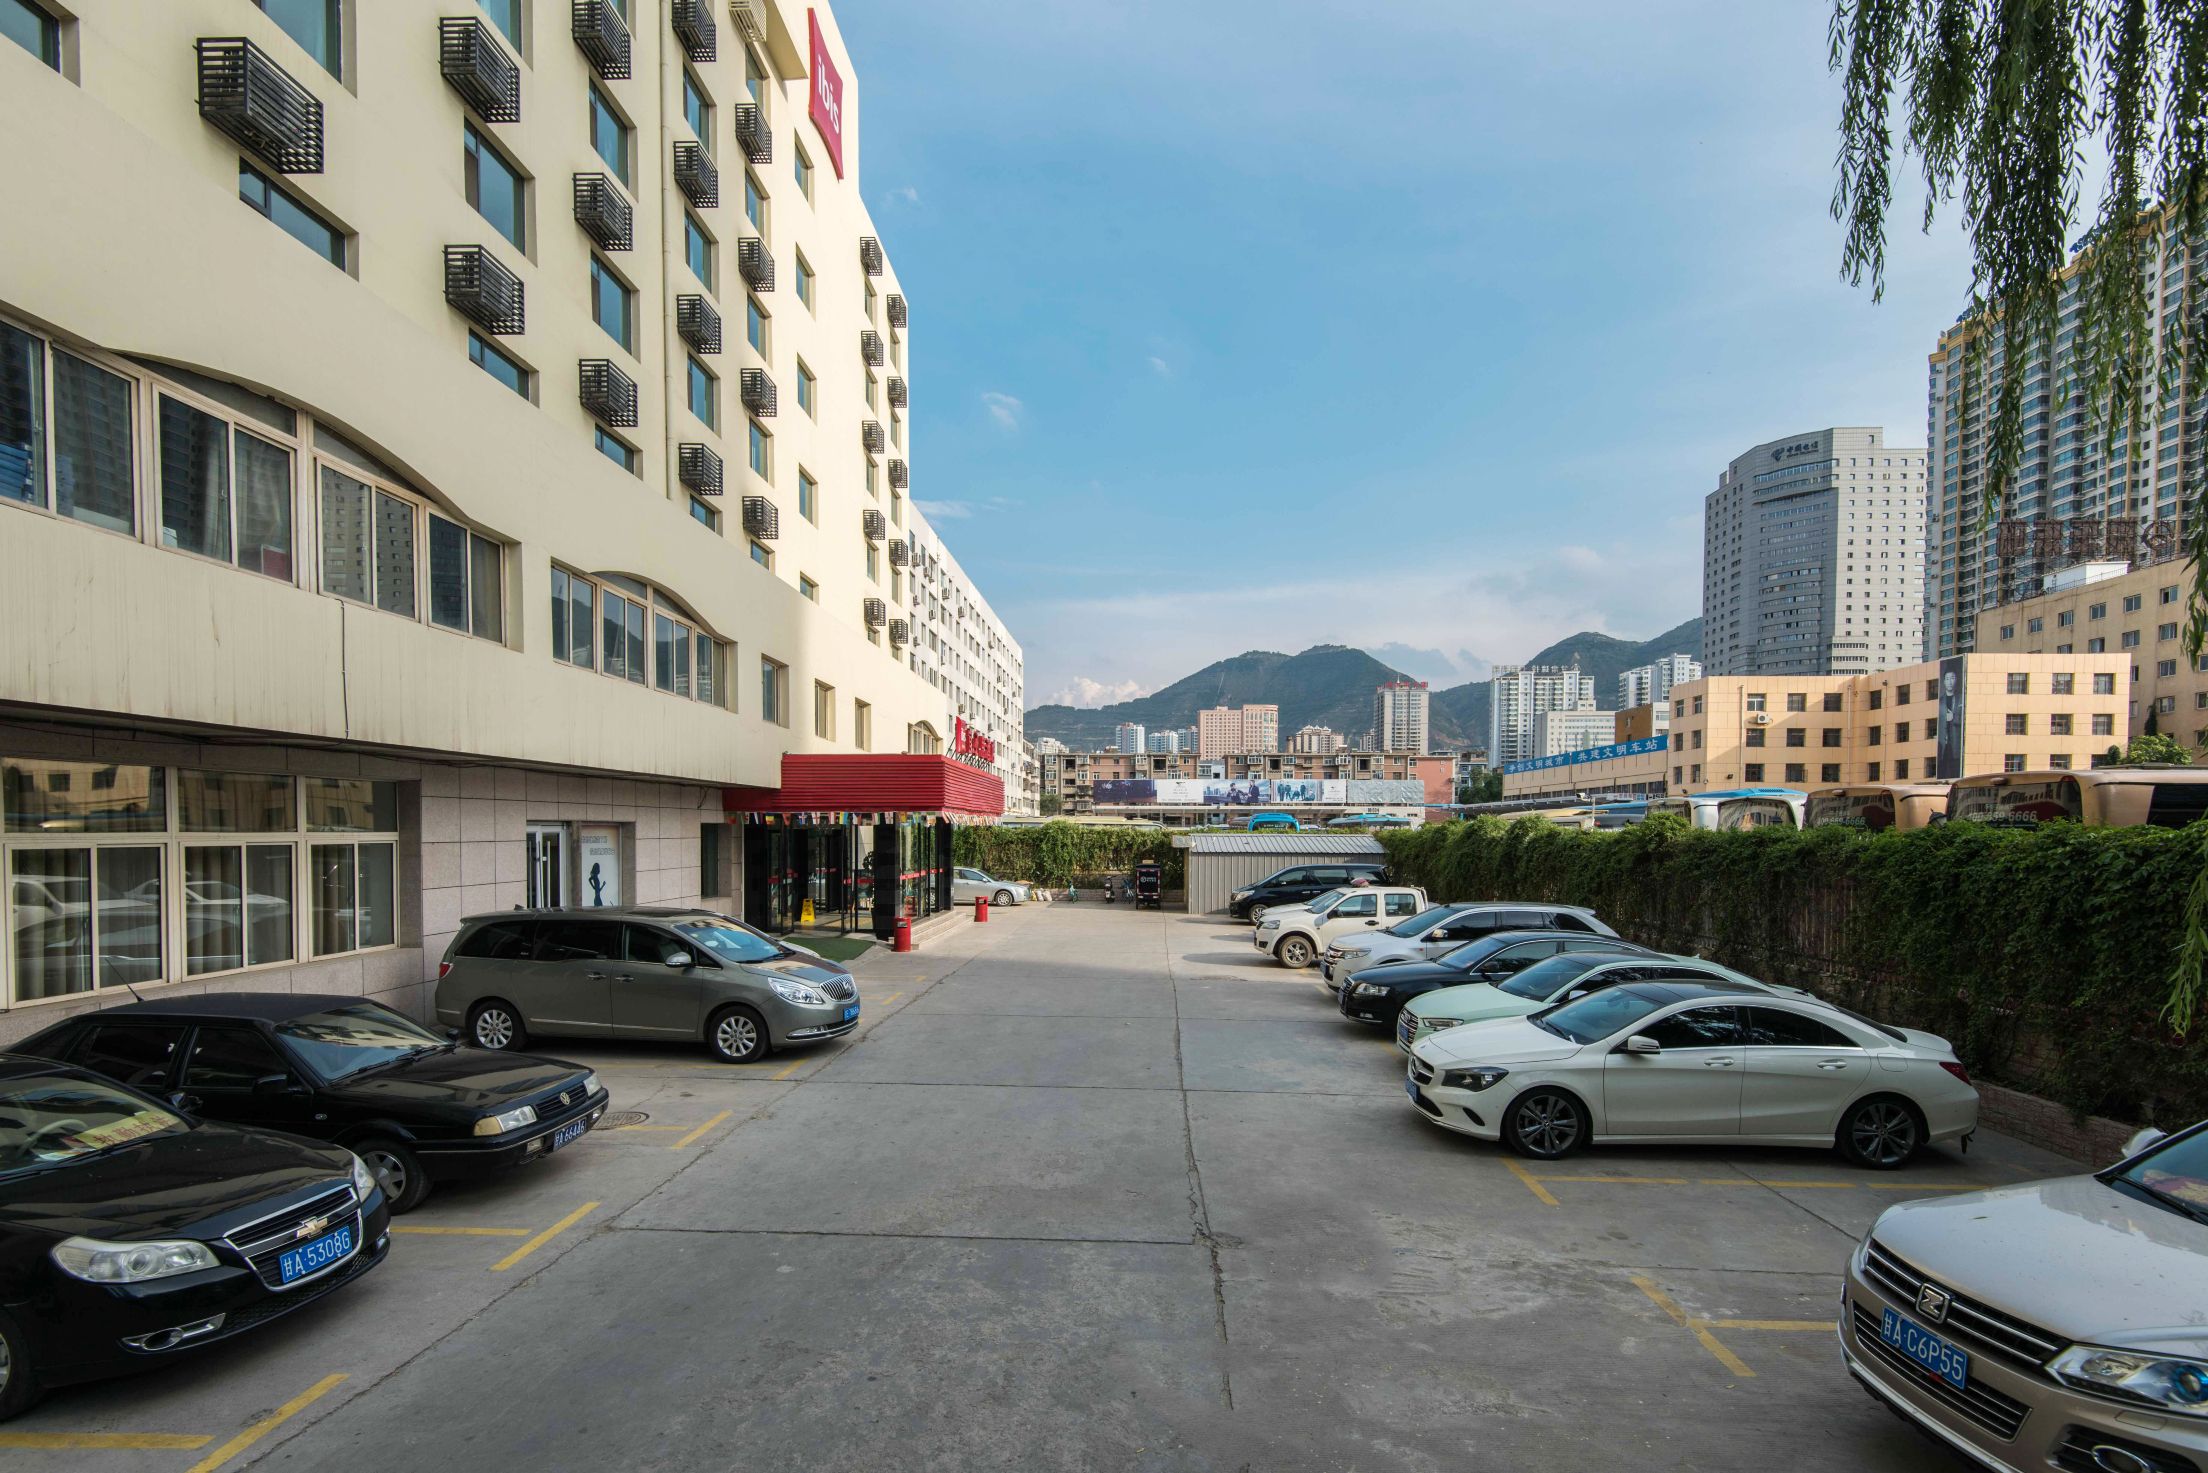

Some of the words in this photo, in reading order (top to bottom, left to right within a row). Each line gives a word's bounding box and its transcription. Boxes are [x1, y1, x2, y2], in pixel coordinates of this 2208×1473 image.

[817, 54, 840, 134] ibis
[1578, 739, 1658, 762] 共建文明车站
[1509, 756, 1563, 773] 争创文明城市
